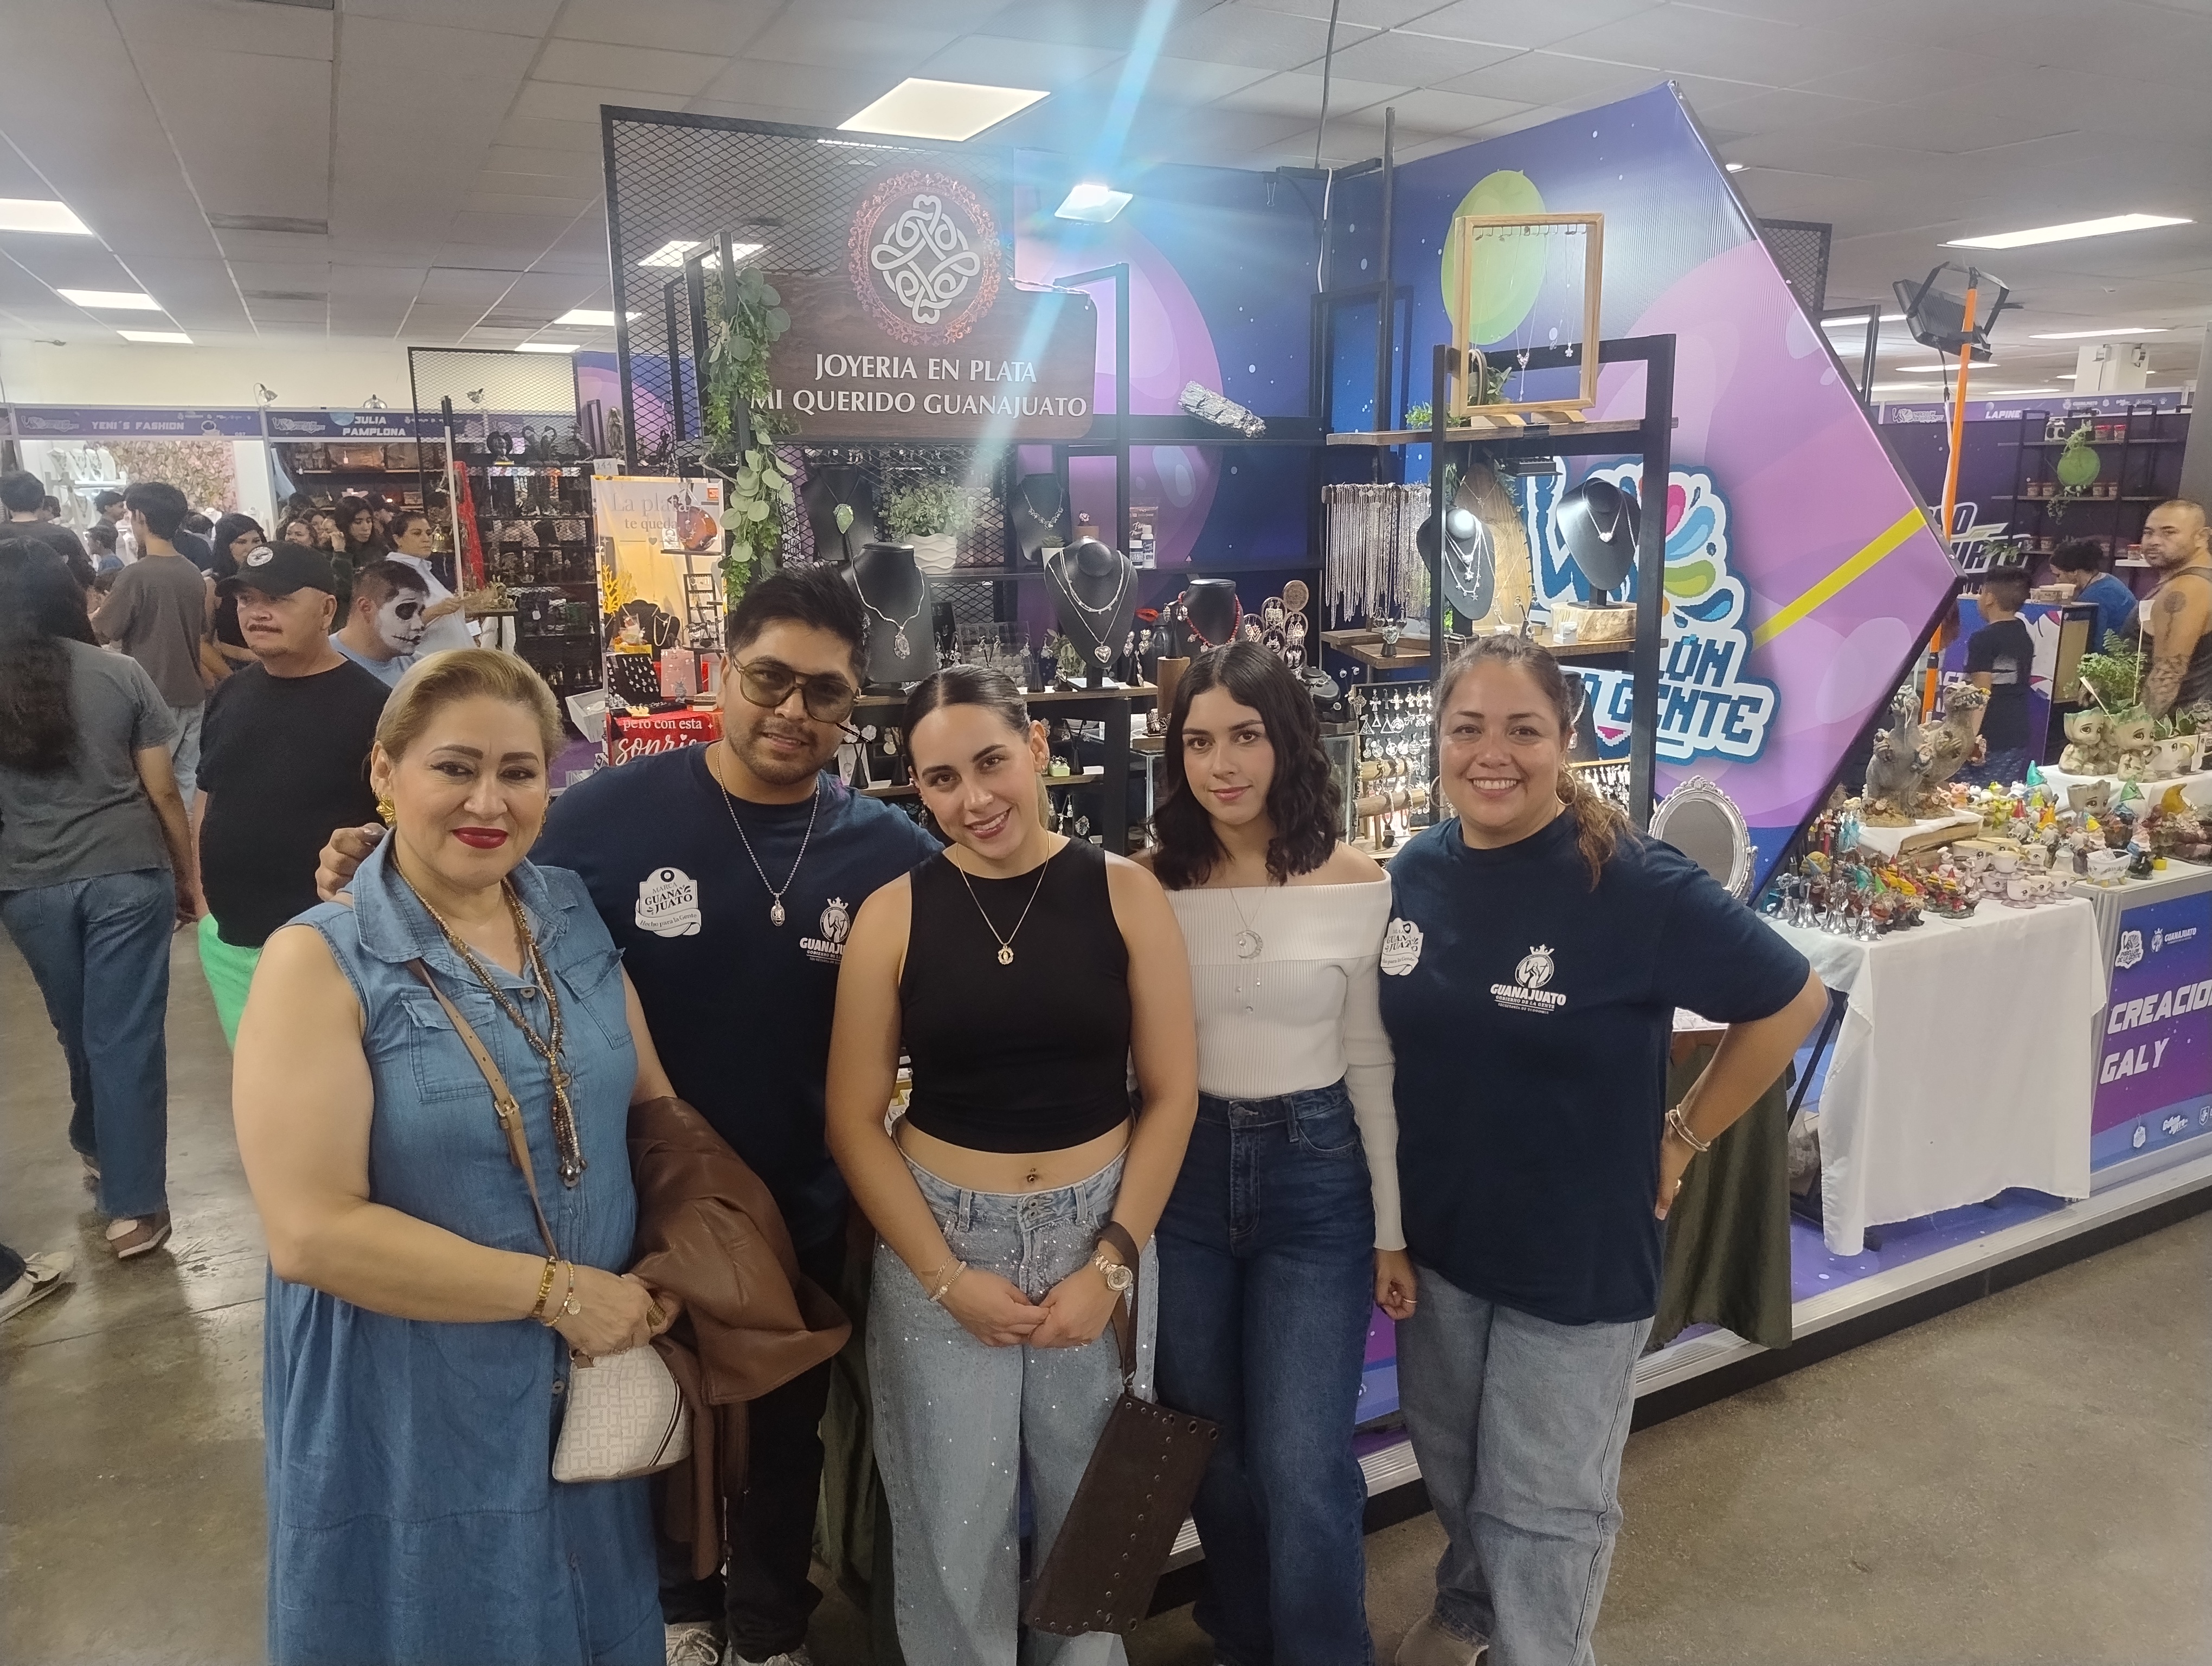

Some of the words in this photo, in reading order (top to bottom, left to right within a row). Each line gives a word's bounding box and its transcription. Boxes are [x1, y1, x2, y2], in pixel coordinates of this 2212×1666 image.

[815, 354, 918, 380] JOYERIA
[928, 358, 959, 380] EN
[970, 360, 1037, 383] PLATA
[793, 389, 915, 415] QUERIDO
[923, 394, 1086, 419] GUANAJUATO
[354, 416, 387, 425] JULIA
[1985, 411, 2021, 419] LAPINE
[135, 422, 184, 430] FASHION
[343, 427, 406, 436] PAMPLONA
[611, 492, 635, 512] La
[642, 492, 690, 516] plata
[625, 518, 638, 529] te
[623, 719, 651, 731] pero
[654, 720, 676, 729] con
[679, 720, 703, 729] esta
[645, 888, 682, 906] GUANA
[652, 882, 678, 894] MARCA
[655, 894, 693, 914] JUATO
[1490, 983, 1567, 1006] GUANAJUATO
[2107, 979, 2212, 1035] CREACIO
[2099, 1038, 2170, 1085] GALY
